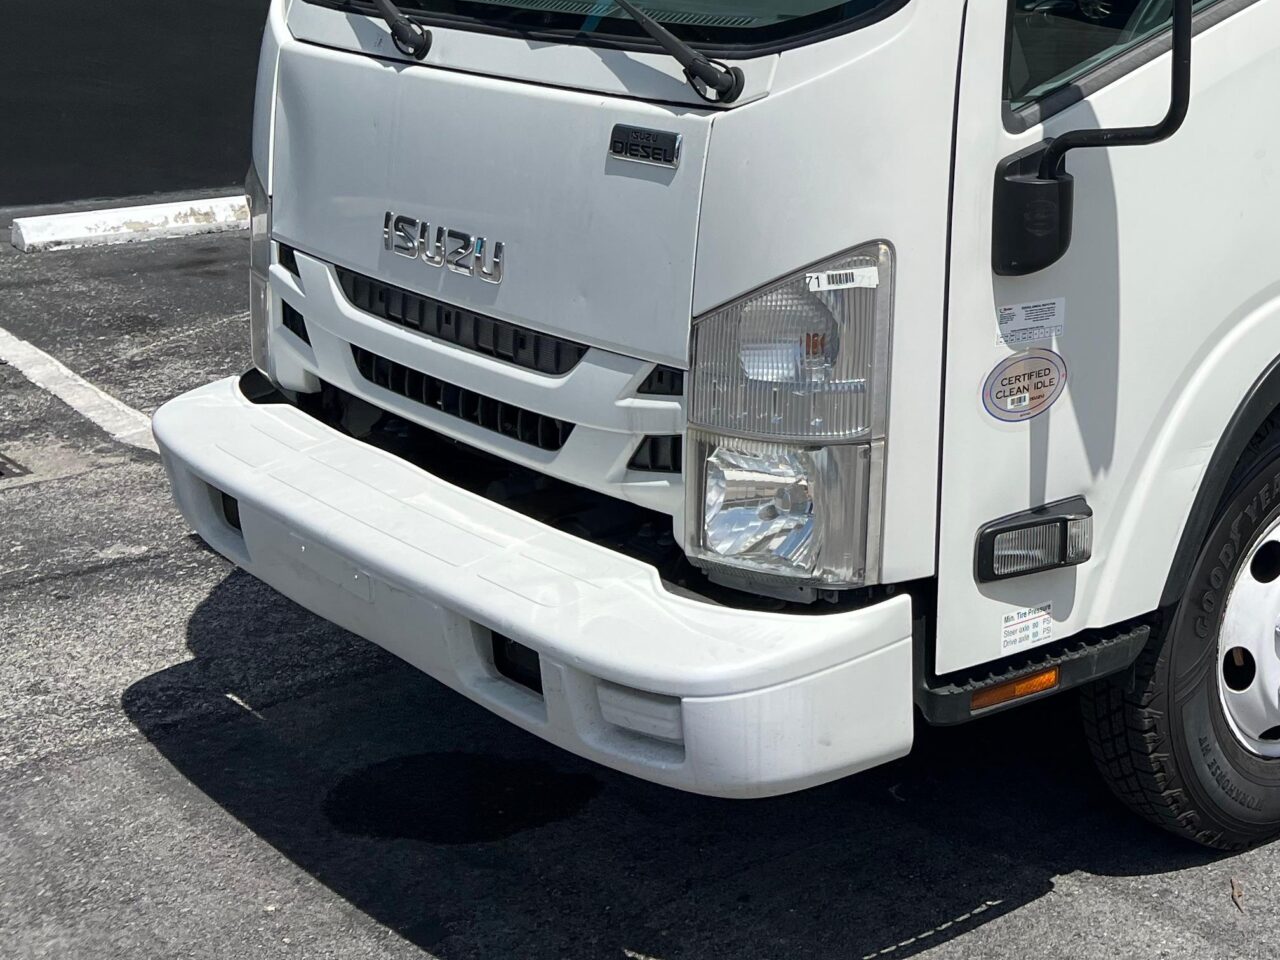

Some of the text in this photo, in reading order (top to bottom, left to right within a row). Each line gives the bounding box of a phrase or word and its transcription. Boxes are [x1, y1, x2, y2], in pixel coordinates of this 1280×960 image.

[631, 131, 659, 142] ISUZU
[611, 141, 678, 163] DIESEL
[383, 210, 505, 284] ISUZU
[1001, 368, 1051, 387] CERTIFIED
[996, 378, 1055, 400] CLEAN IDLE
